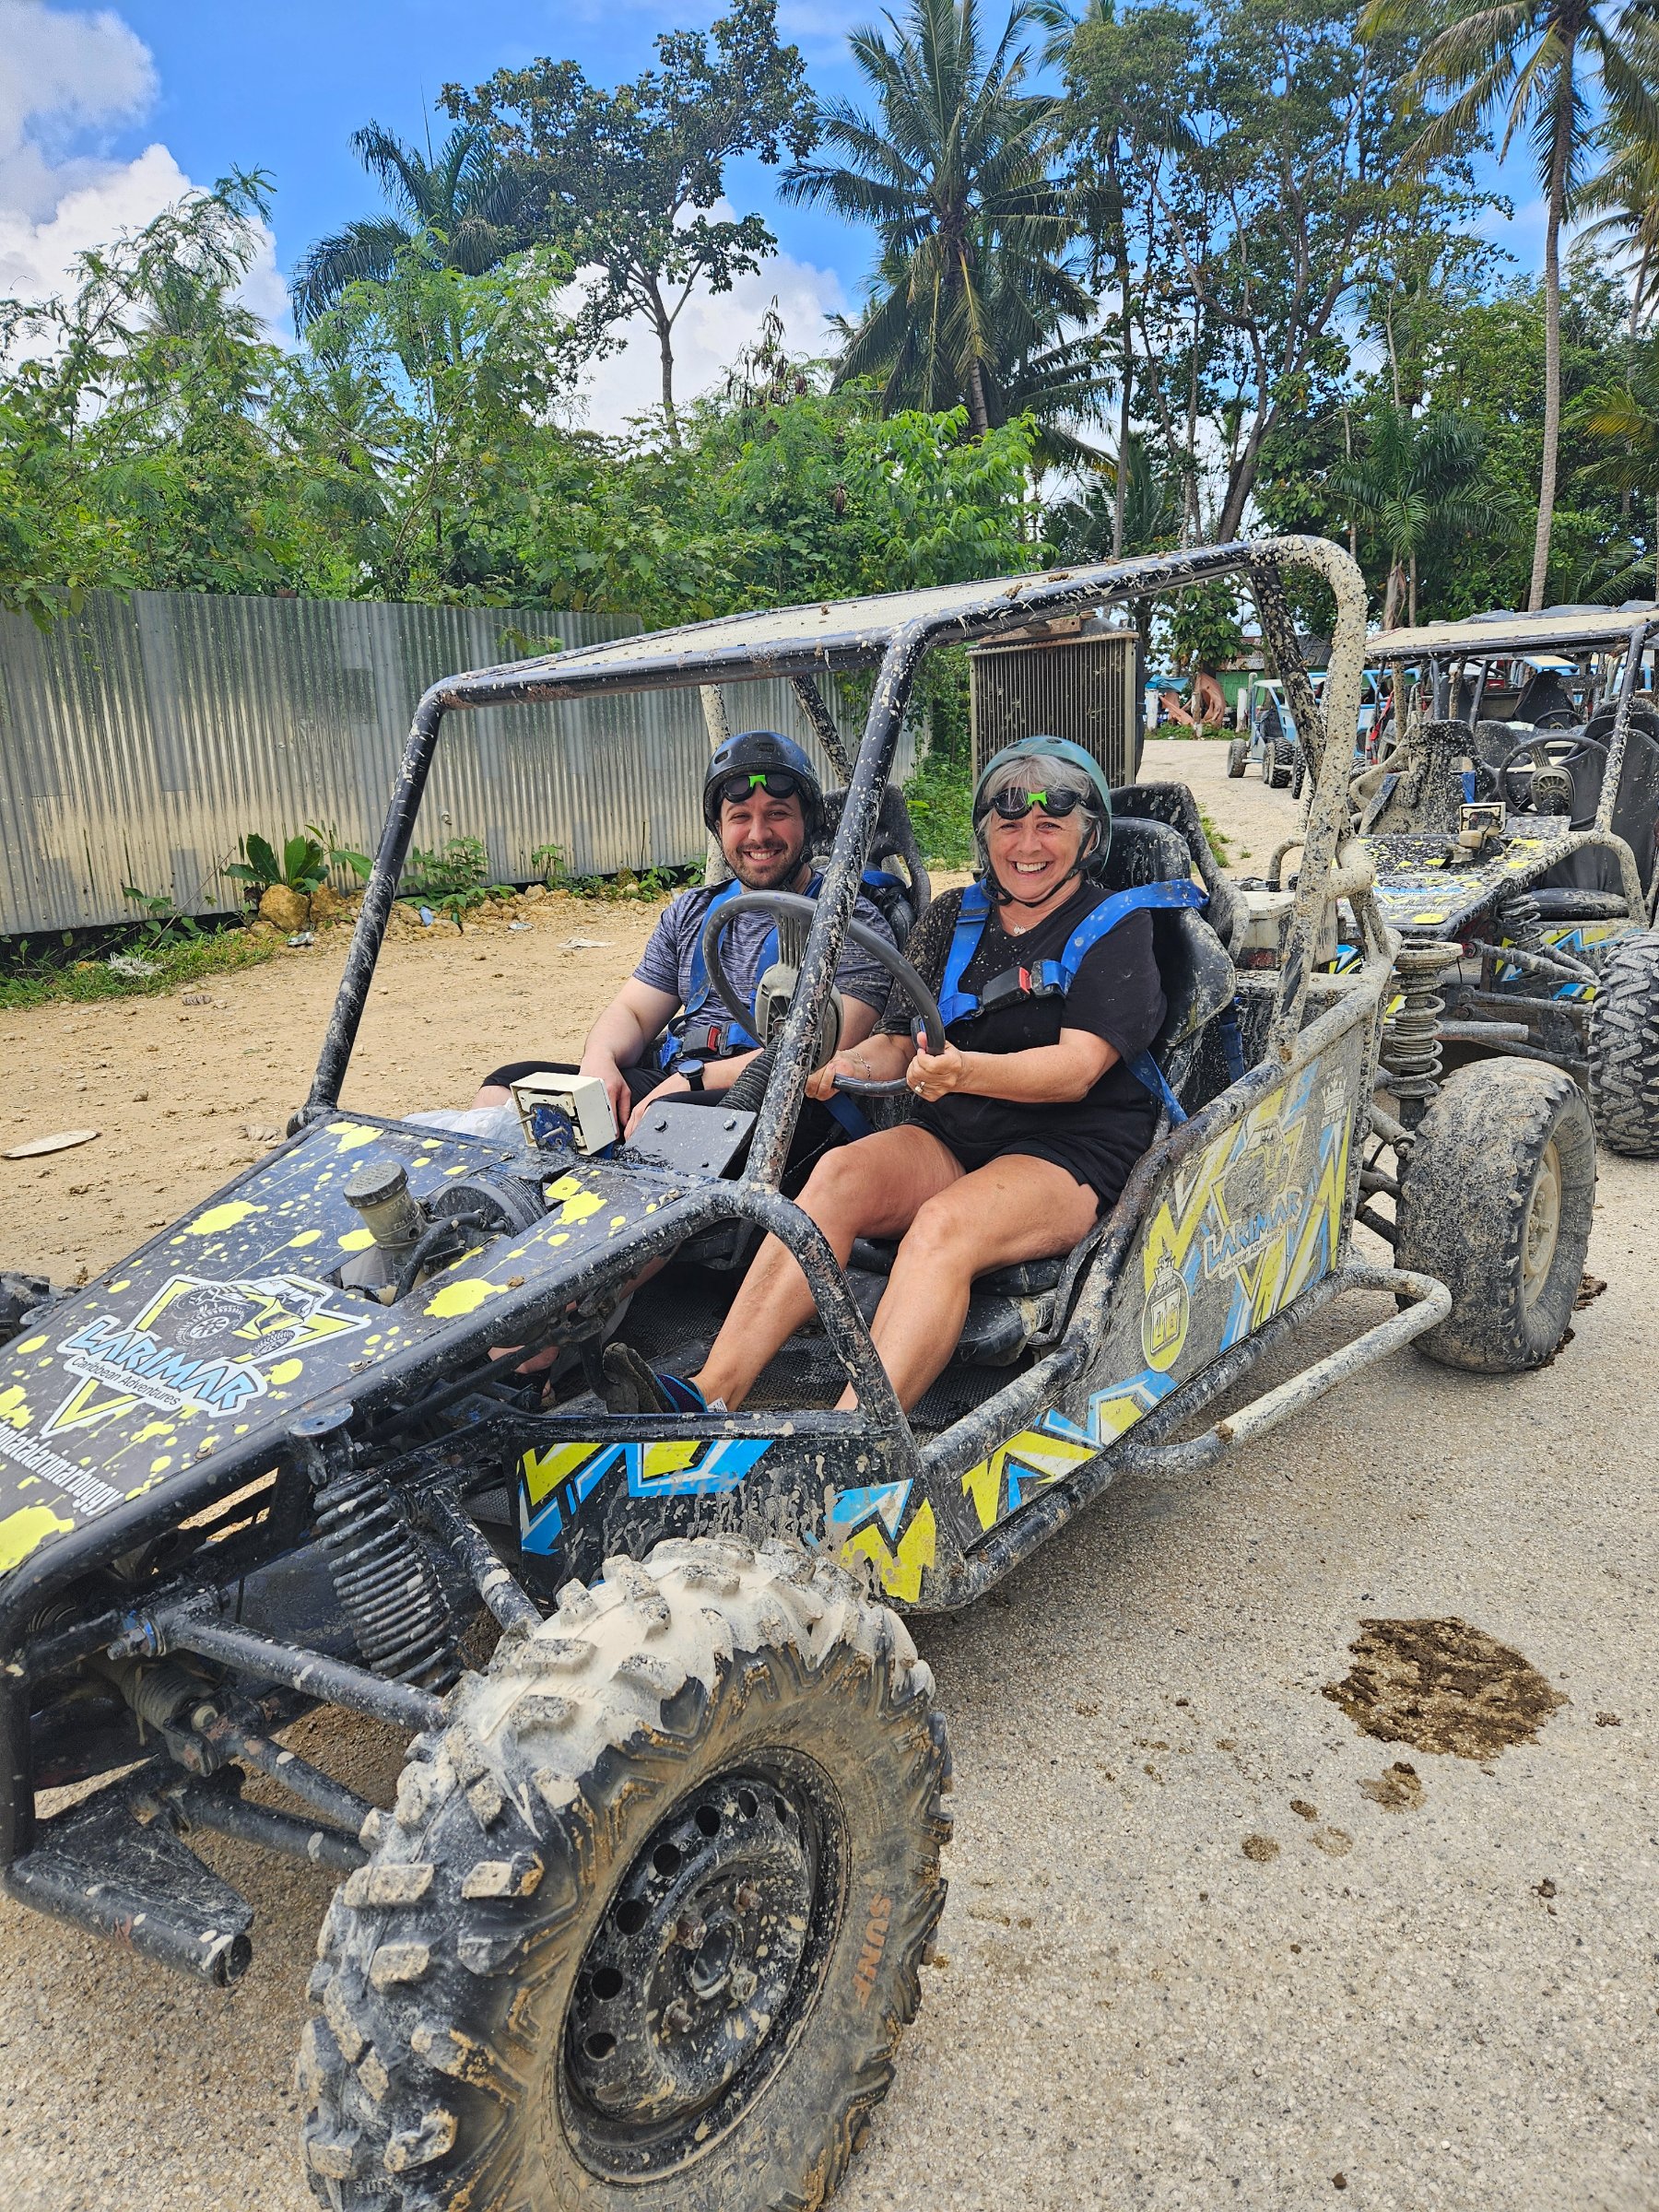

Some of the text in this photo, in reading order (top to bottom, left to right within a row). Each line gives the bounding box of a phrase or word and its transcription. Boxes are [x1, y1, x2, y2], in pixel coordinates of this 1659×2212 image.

[1206, 1193, 1300, 1271] LARIMAR
[65, 1320, 259, 1411] LARIMAR
[72, 1357, 181, 1406] Caribbean Adventures
